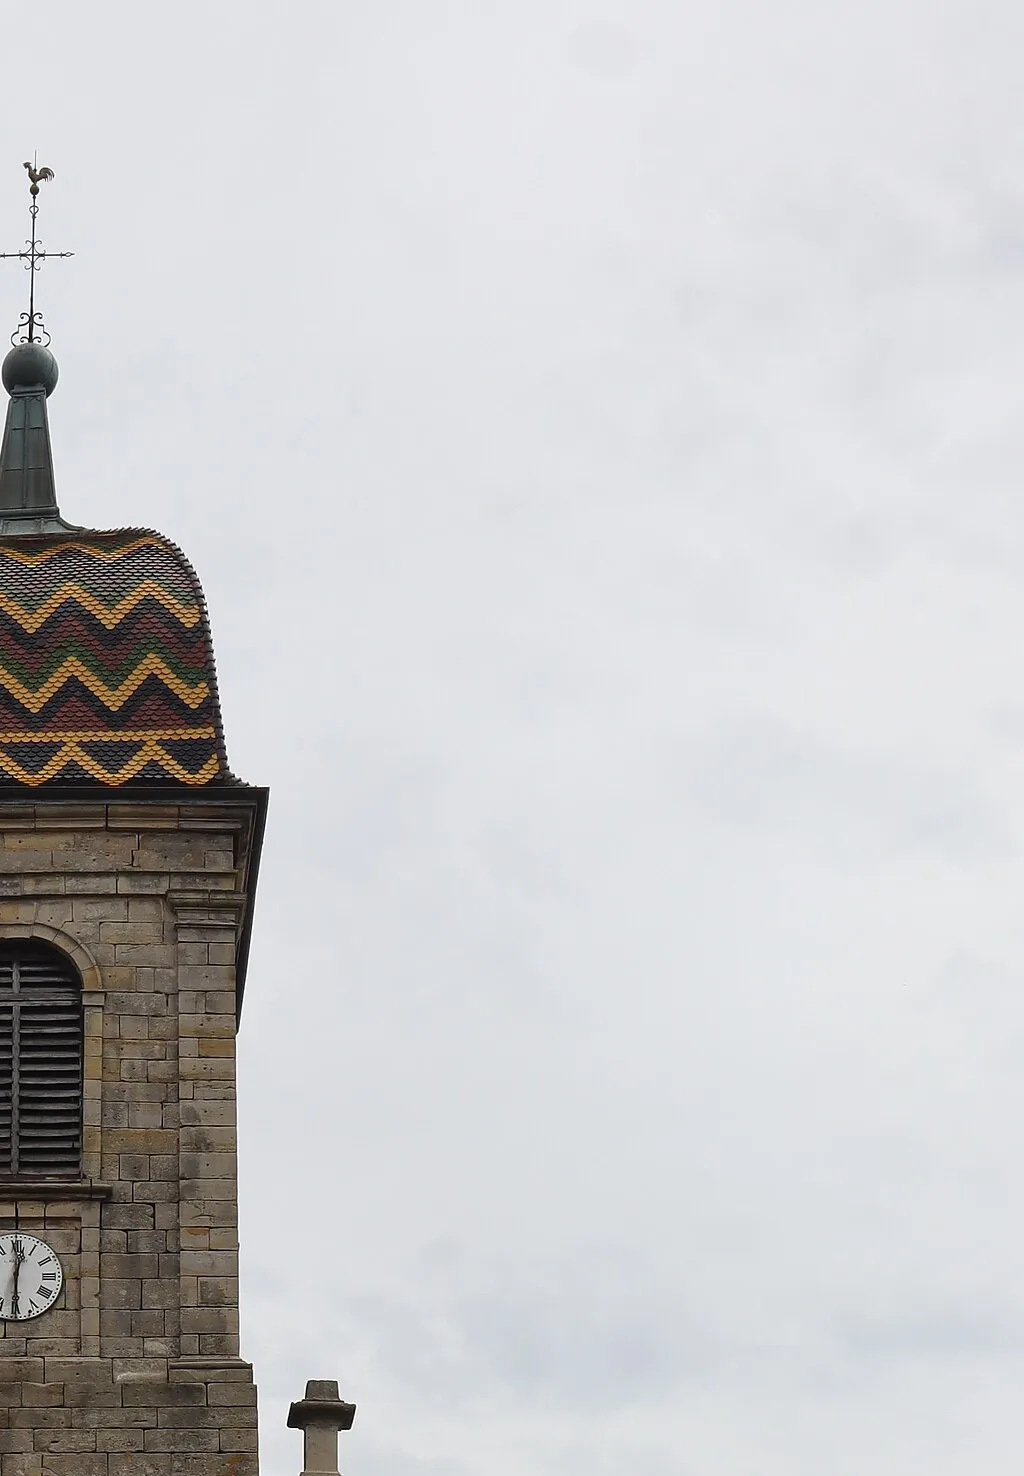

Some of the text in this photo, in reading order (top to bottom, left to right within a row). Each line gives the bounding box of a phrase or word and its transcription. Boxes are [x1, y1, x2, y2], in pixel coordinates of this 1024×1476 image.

[28, 1244, 37, 1256] I
[38, 1256, 52, 1267] II
[28, 1298, 39, 1311] V
